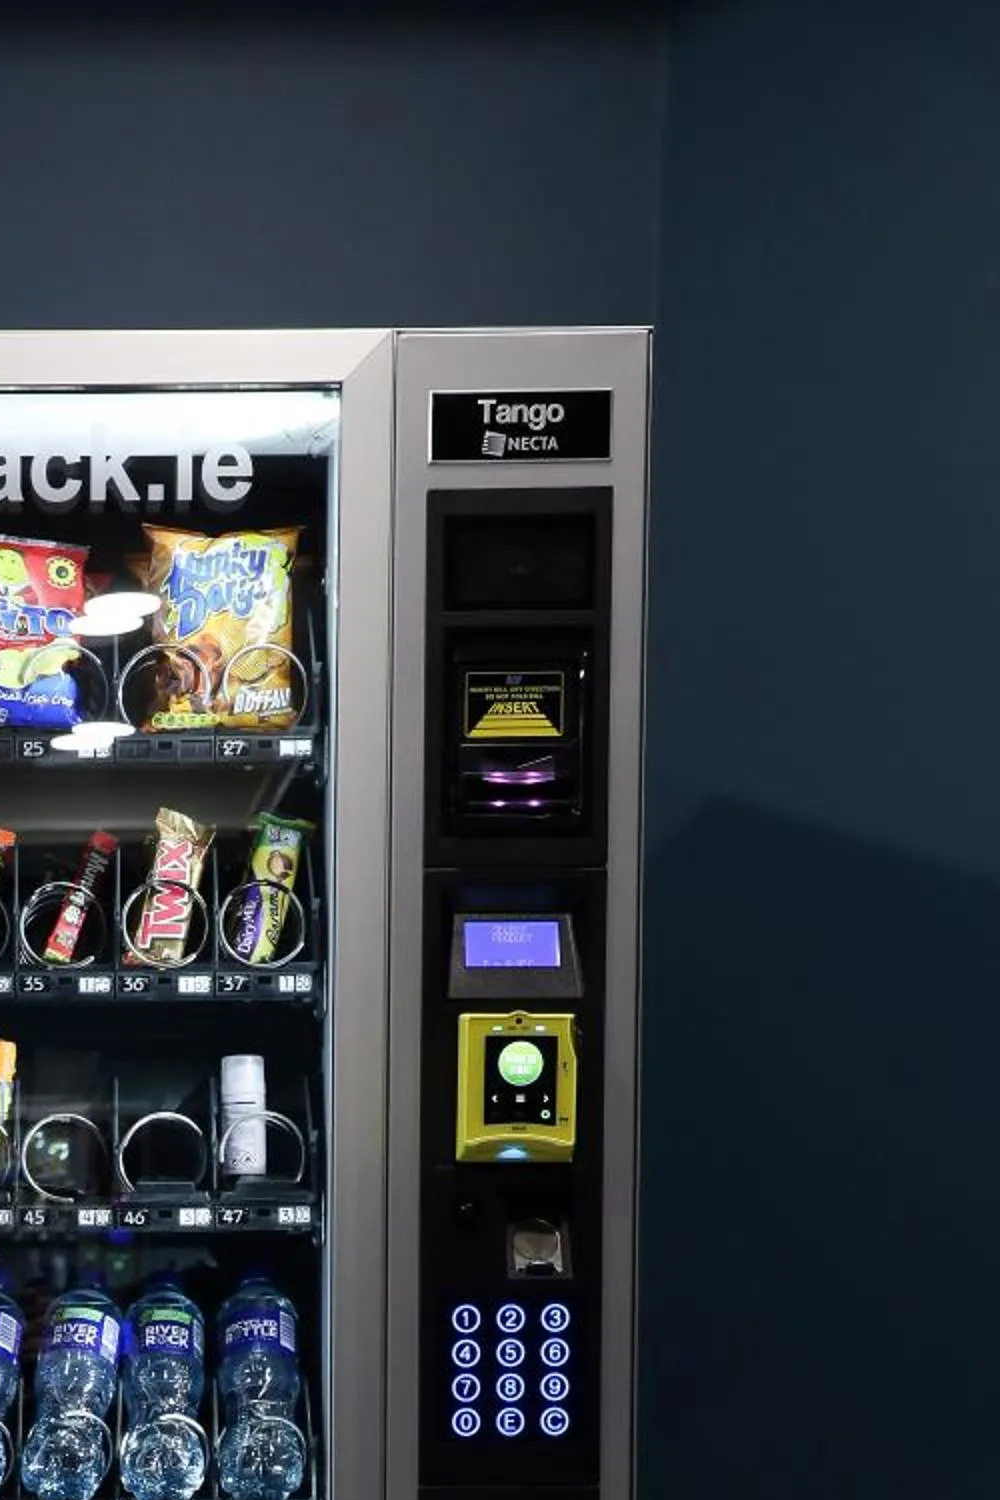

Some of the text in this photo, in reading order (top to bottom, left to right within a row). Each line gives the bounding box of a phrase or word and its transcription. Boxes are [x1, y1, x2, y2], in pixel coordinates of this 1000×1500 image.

[477, 398, 565, 430] Tango
[508, 436, 559, 451] NECTA
[487, 701, 540, 713] INSERT
[24, 742, 44, 756] 25
[223, 741, 244, 755] 27
[137, 840, 193, 949] TWIX
[24, 976, 44, 991] 35
[124, 977, 144, 991] 36
[224, 977, 243, 991] 37
[24, 1210, 44, 1224] 45
[124, 1210, 144, 1224] 46
[223, 1209, 242, 1223] 47
[462, 1310, 562, 1326] 1 2 3
[145, 1325, 189, 1336] RIVER
[459, 1344, 561, 1360] 4 5 6
[460, 1379, 561, 1395] 7 8 9
[460, 1414, 562, 1430] 0 E C
